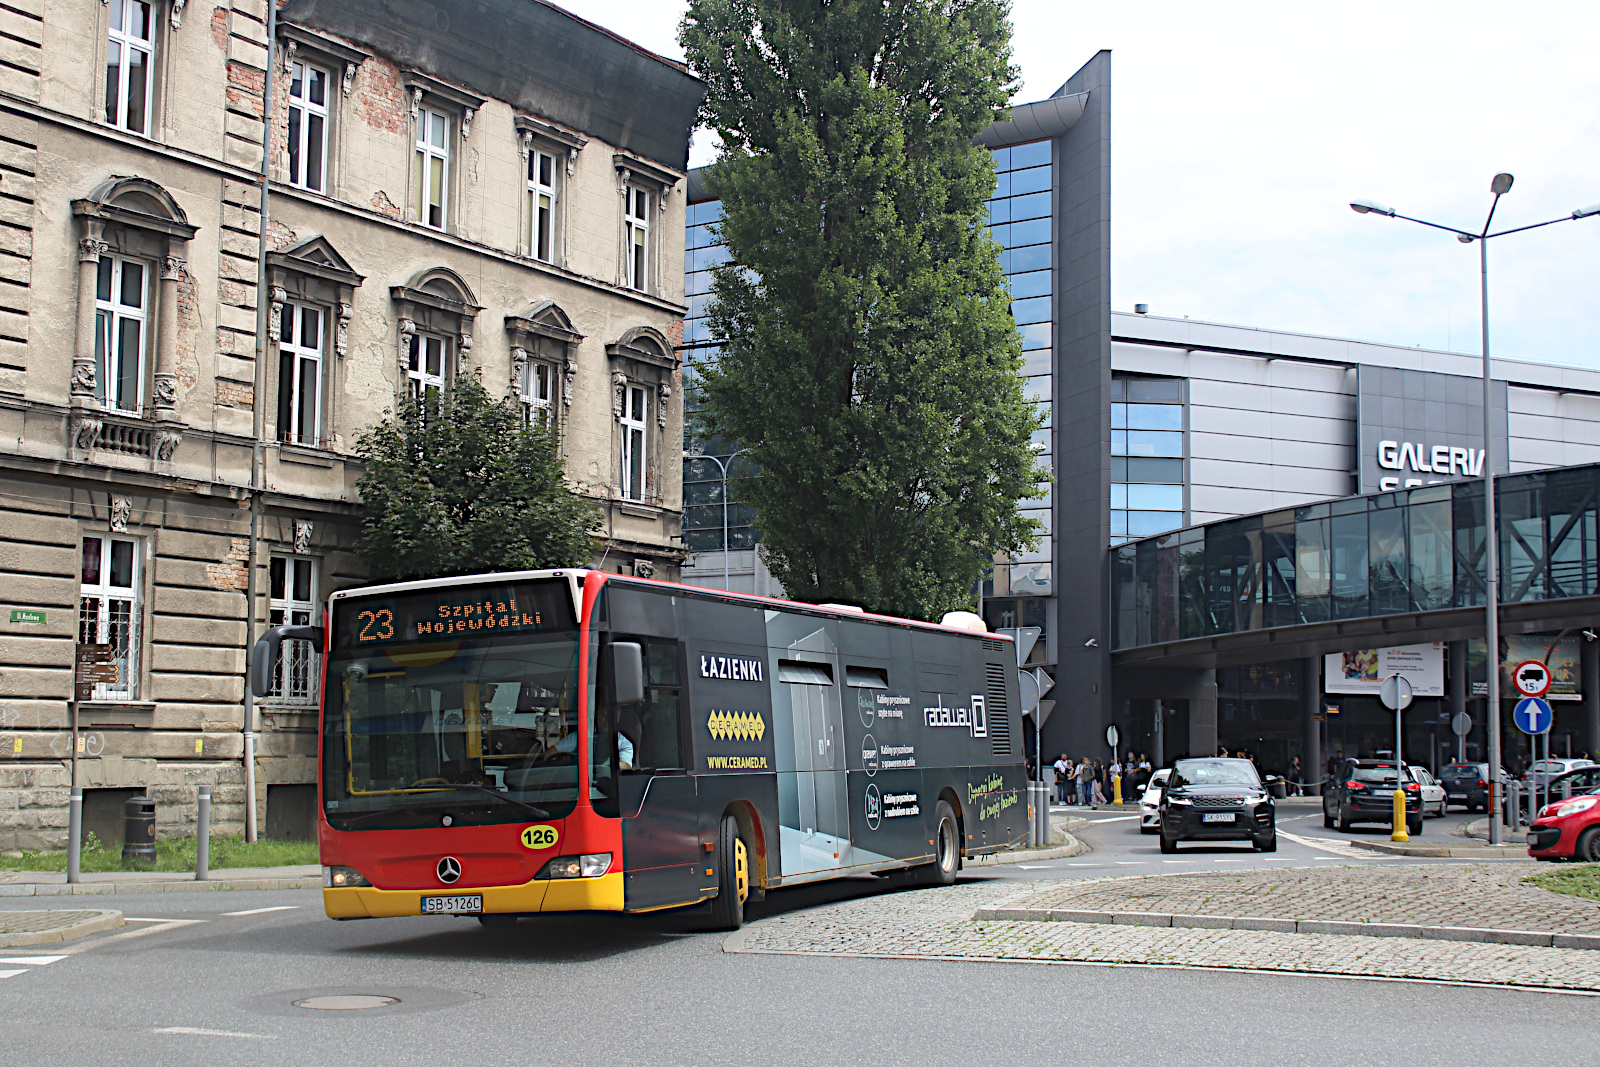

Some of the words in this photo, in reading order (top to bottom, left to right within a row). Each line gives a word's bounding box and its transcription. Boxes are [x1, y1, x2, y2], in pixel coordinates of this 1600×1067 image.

[438, 599, 518, 618] Szpital
[358, 608, 394, 642] 23
[417, 612, 542, 634] Wojewódzki
[700, 655, 762, 682] ŁAZIENKI
[1525, 683, 1535, 691] 15
[924, 694, 973, 738] radaway
[710, 720, 762, 732] CERAMED
[707, 756, 768, 769] WWW.CERAMED.PL
[524, 829, 554, 844] 126
[428, 898, 443, 910] SB
[447, 897, 480, 909] 5126C
